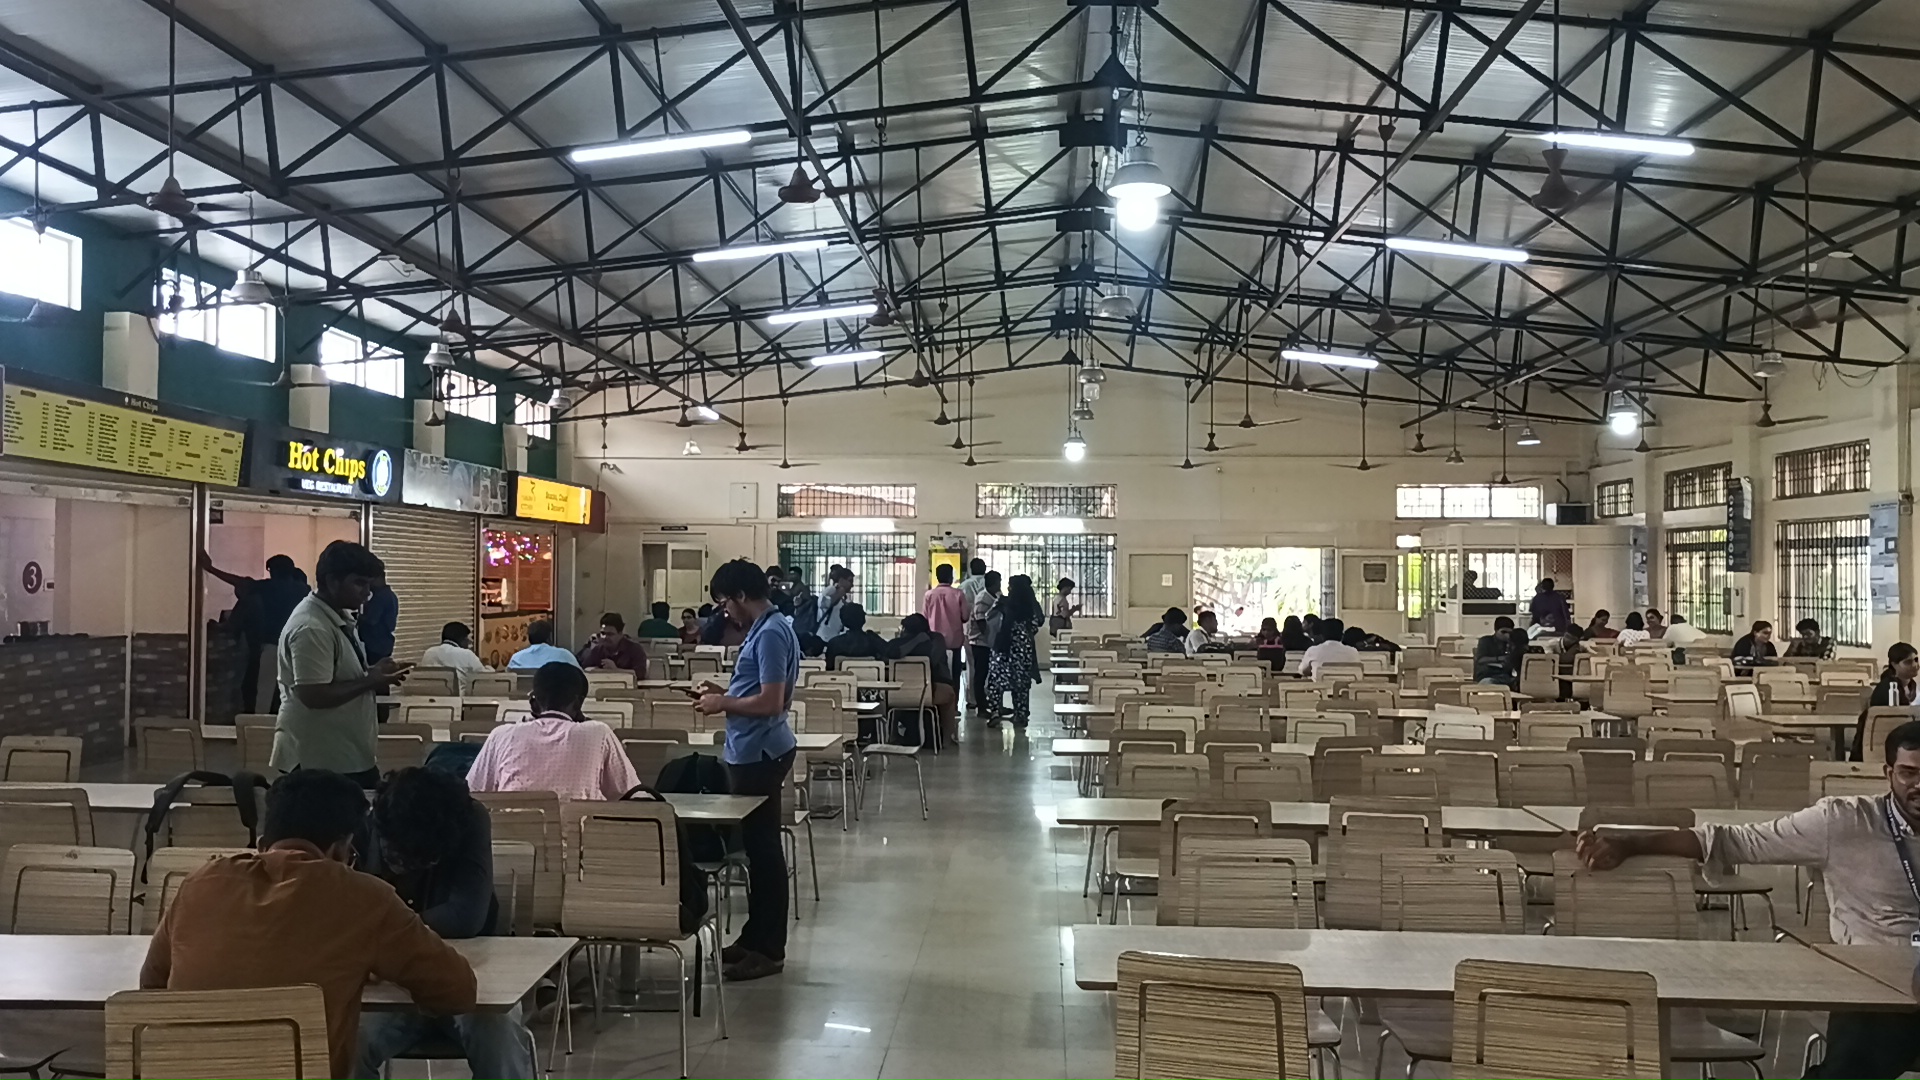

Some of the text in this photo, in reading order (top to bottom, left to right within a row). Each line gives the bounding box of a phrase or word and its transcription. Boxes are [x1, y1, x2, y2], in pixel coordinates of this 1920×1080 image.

[288, 441, 366, 484] Hot Chips
[27, 565, 37, 589] 3
